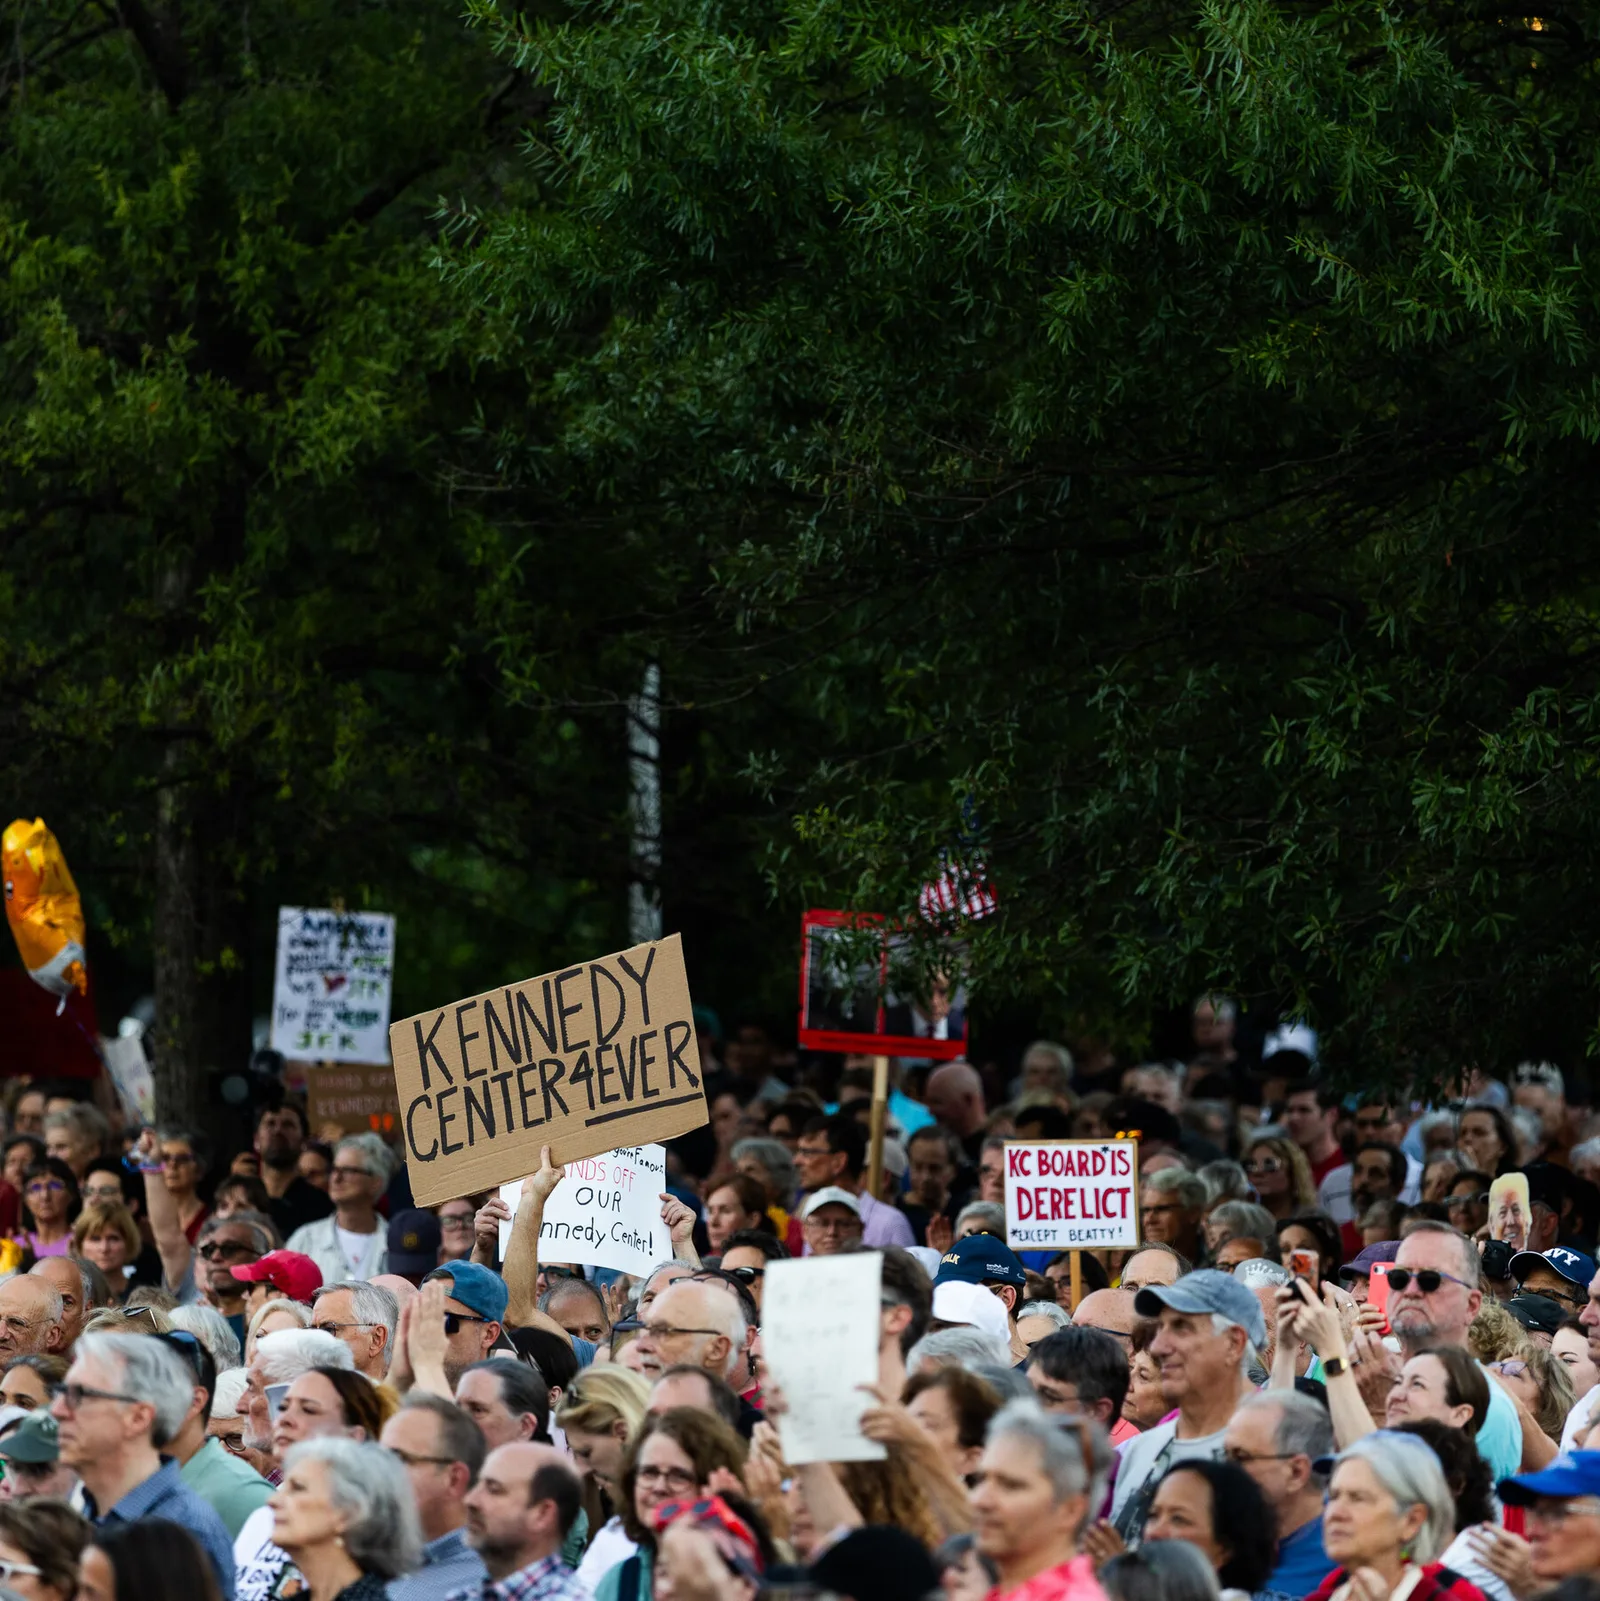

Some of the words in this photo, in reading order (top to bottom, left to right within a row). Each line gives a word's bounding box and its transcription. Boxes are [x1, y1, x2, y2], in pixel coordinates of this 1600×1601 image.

[413, 947, 656, 1091] KENNEDY
[564, 1158, 606, 1182] NDS
[613, 1165, 637, 1192] OFF
[1008, 1149, 1031, 1177] KC
[1111, 1149, 1130, 1176] IS
[575, 1186, 622, 1213] OUR
[1016, 1186, 1131, 1220] DERELICT
[513, 1213, 606, 1249] nnedy
[610, 1221, 653, 1256] Center!
[1069, 1226, 1122, 1242] BEATTY!
